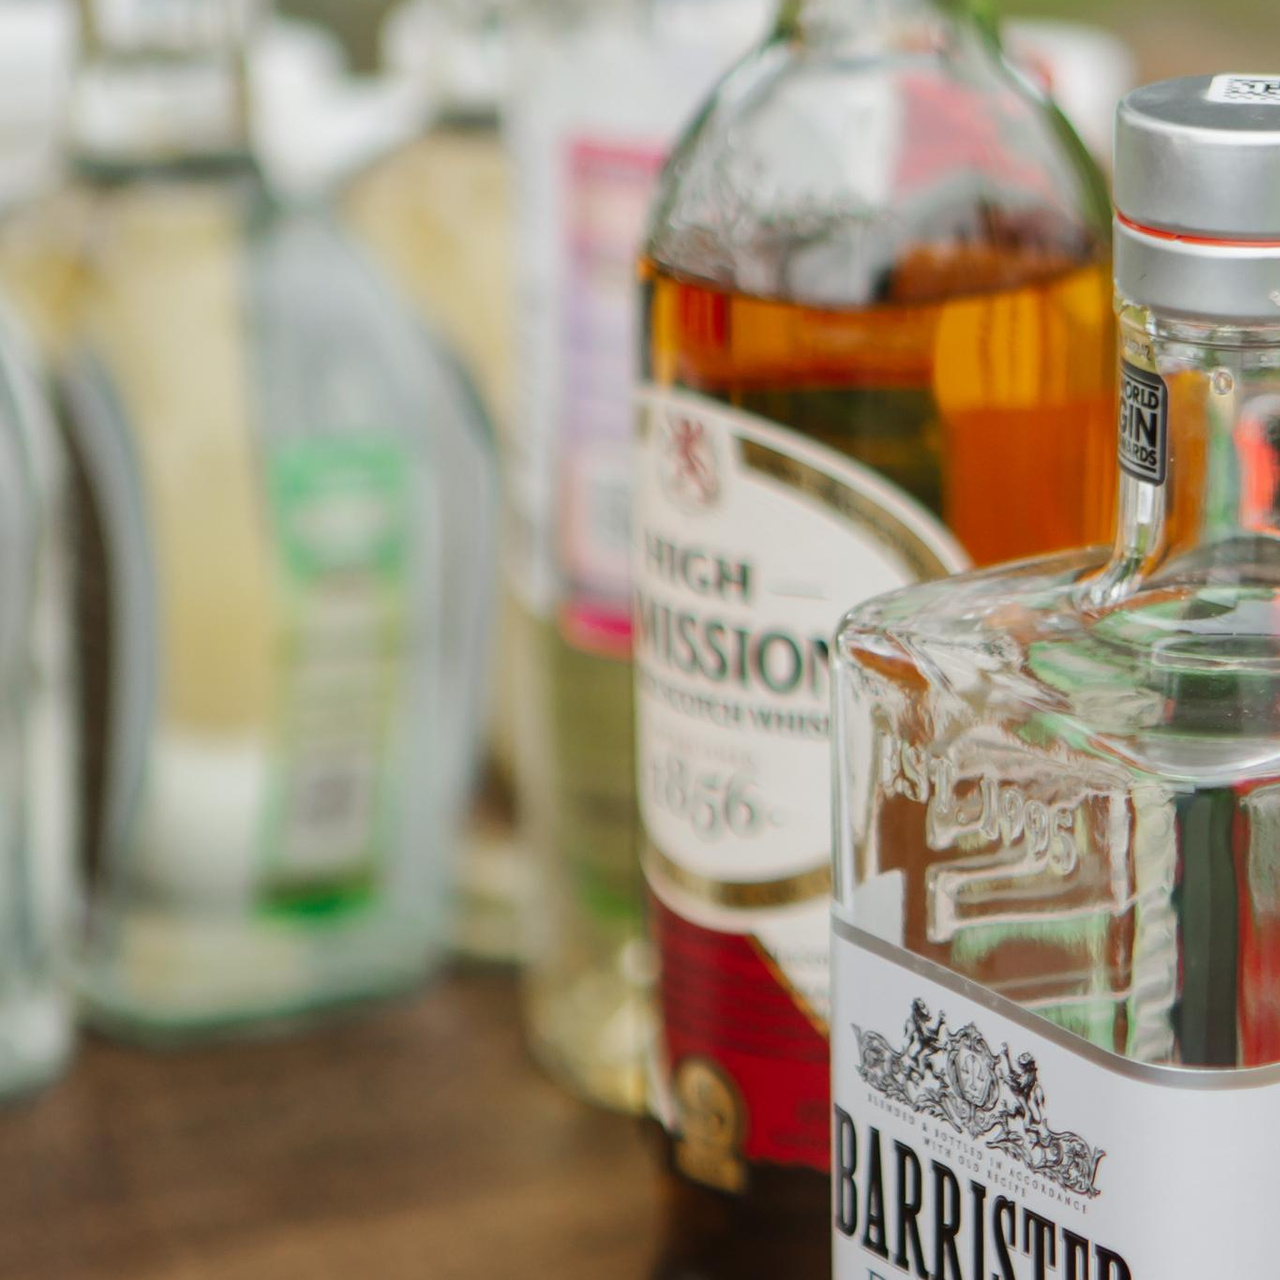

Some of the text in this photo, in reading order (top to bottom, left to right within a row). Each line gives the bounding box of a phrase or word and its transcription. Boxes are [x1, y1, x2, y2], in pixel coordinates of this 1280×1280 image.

[1121, 379, 1160, 411] ORLD
[923, 1136, 1027, 1198] WITH OLD RECIPE
[1008, 1169, 1089, 1215] ACCORDANCE
